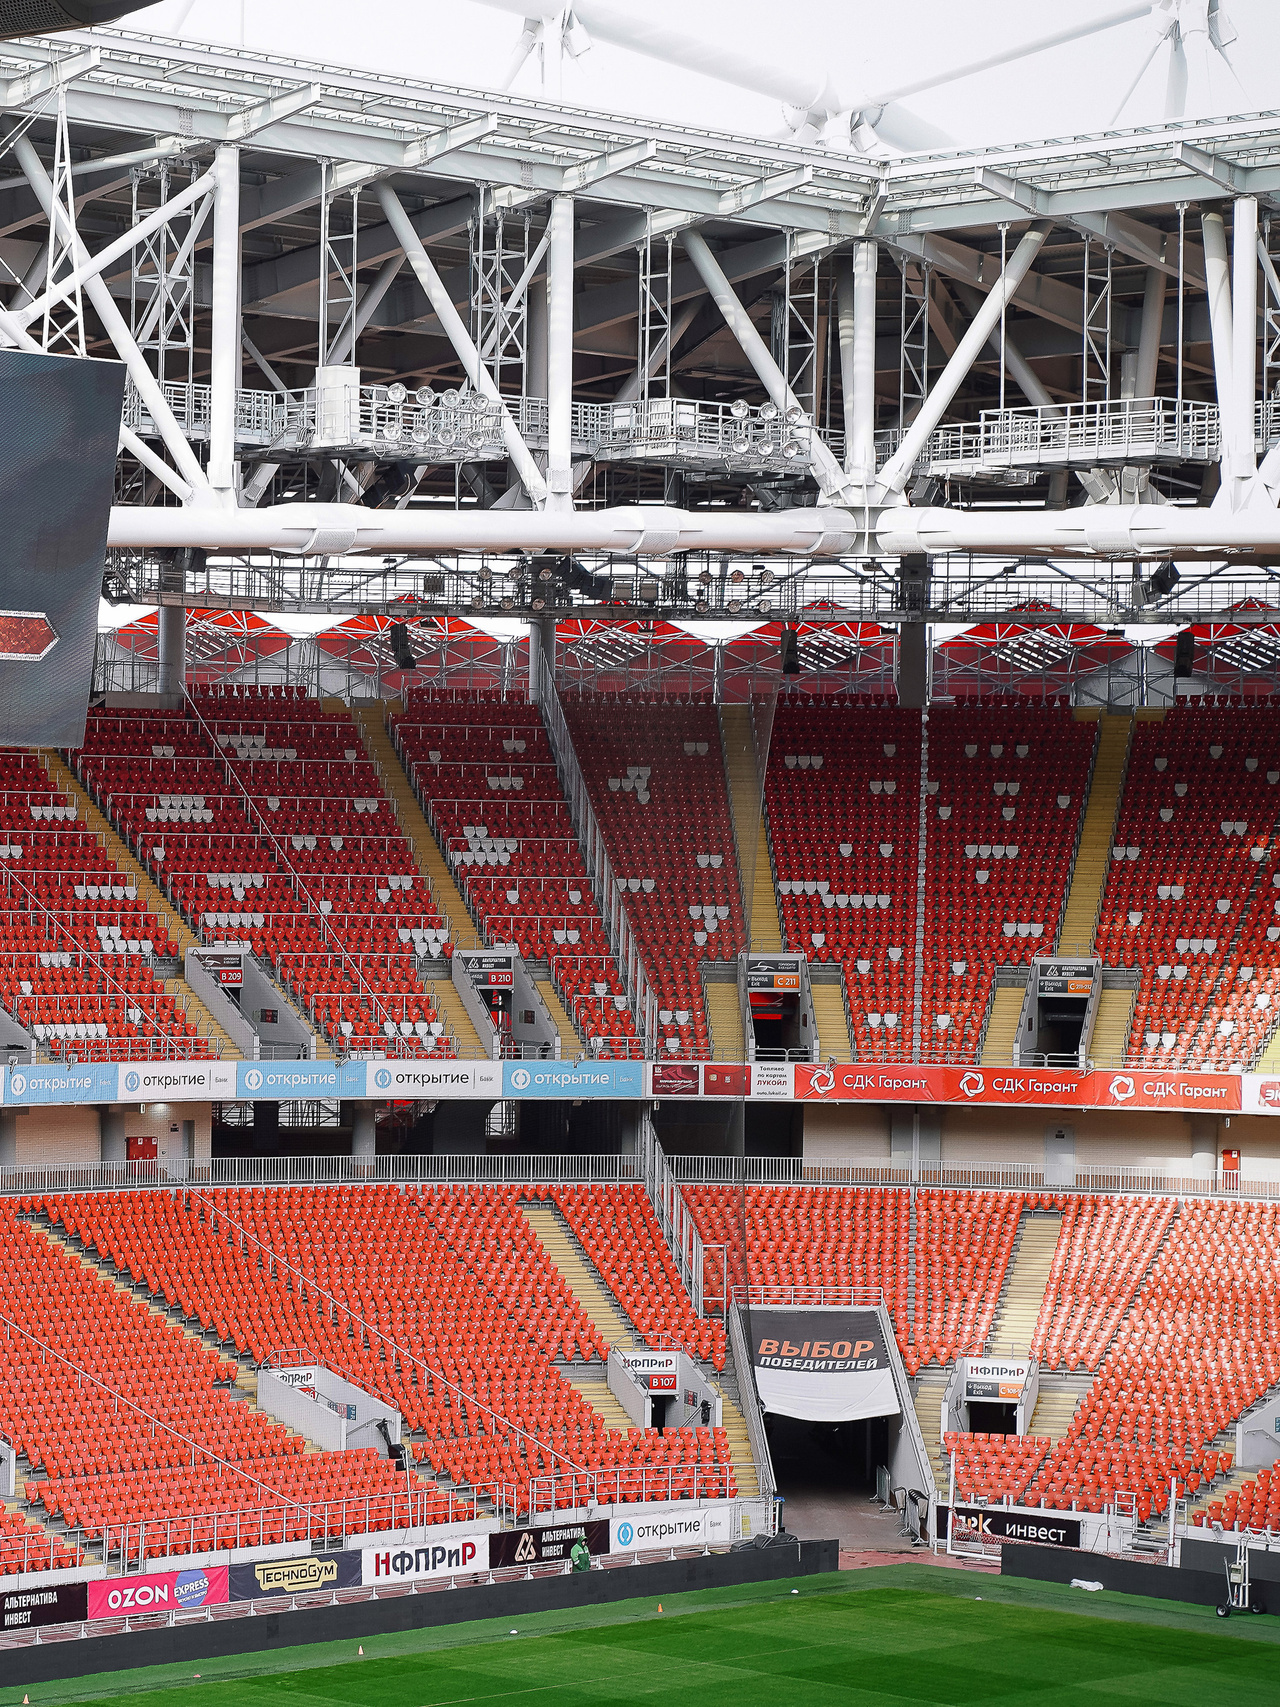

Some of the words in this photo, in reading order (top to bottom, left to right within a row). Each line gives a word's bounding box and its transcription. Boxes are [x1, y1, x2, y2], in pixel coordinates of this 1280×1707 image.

[498, 974, 511, 982] 210
[785, 978, 796, 986] 211
[30, 1076, 92, 1092] открытие
[144, 1074, 205, 1090] открытие
[267, 1072, 336, 1088] открытие
[396, 1072, 469, 1087] открытие
[534, 1072, 610, 1088] открытие
[843, 1074, 875, 1089] СДК
[878, 1075, 928, 1091] Гарант
[992, 1078, 1025, 1093] СДК
[1028, 1079, 1078, 1095] Гарант
[1143, 1082, 1176, 1098] СДК
[1179, 1084, 1228, 1100] Гарант
[758, 1339, 875, 1358] ВЫБОР
[760, 1356, 878, 1370] ПОБЕДИТЕЛЕЙ
[660, 1378, 674, 1386] 107
[541, 1527, 586, 1542] АЛЬТЕРНАТИВА
[637, 1519, 700, 1539] открытие
[542, 1544, 564, 1558] ИНВЕСТ
[4, 1592, 58, 1610] АЛЬТЕРНАТИВА
[108, 1584, 168, 1610] OZON
[174, 1577, 210, 1598] EXPRESS
[4, 1611, 32, 1626] ИНВЕСТ
